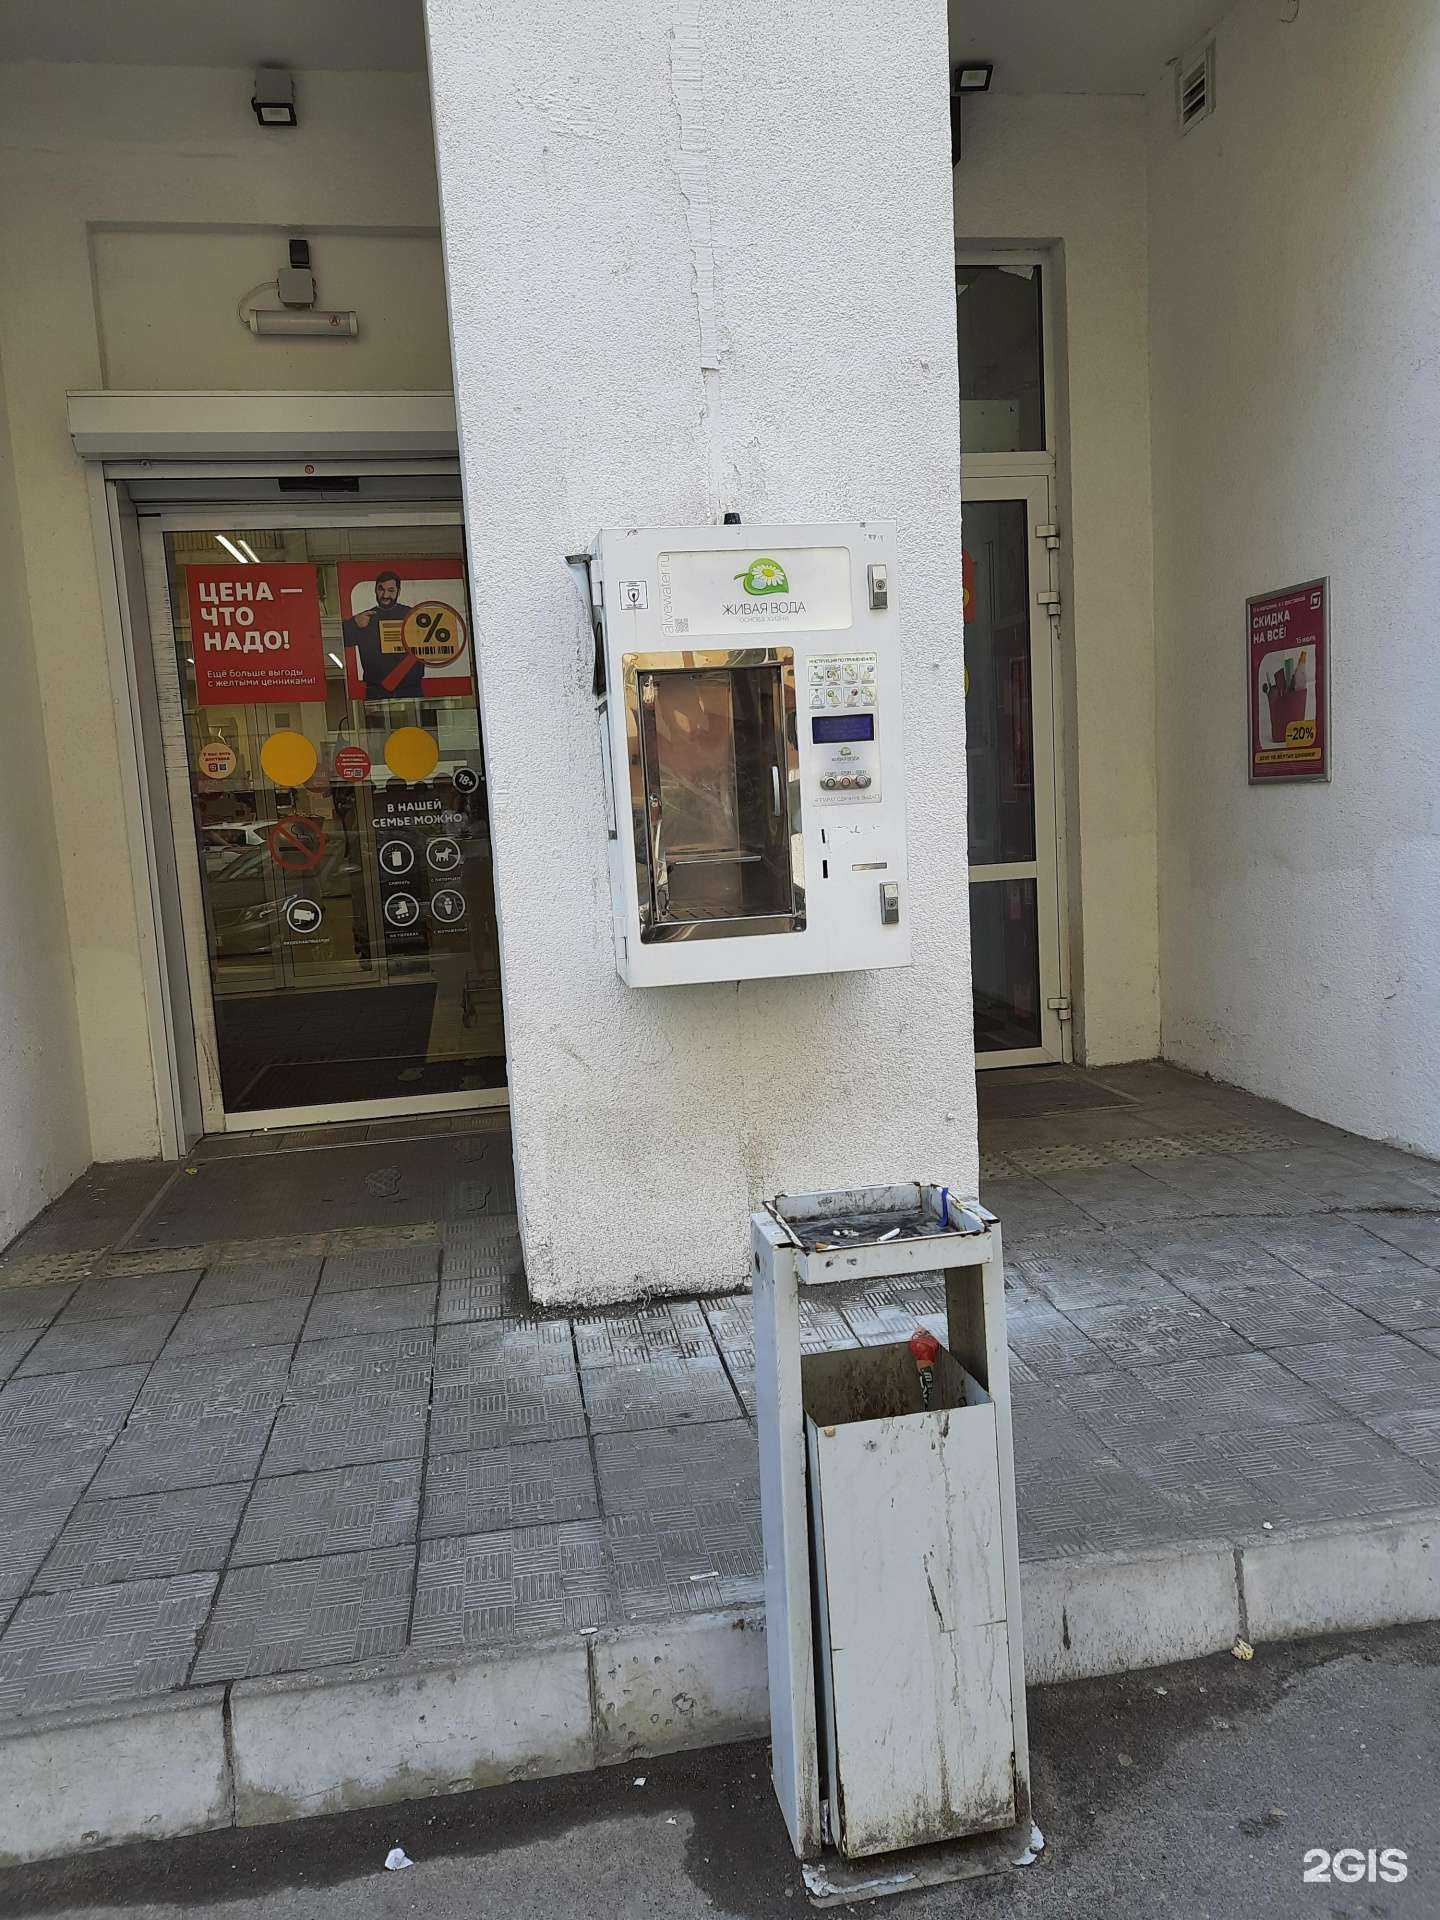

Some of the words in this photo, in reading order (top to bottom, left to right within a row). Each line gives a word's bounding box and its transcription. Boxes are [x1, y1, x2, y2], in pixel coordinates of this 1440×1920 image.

[199, 582, 274, 605] ЦЕНА
[201, 606, 254, 626] ЧТО
[722, 602, 768, 616] ЖИВАЯ
[771, 601, 807, 615] ВОДА
[415, 612, 450, 643] %
[1252, 610, 1291, 629] СКИДКА
[203, 630, 291, 653] НАДО!
[1253, 632, 1266, 644] НА
[1267, 625, 1287, 642] ВСЁ!
[228, 668, 265, 677] больше
[266, 668, 304, 678] выгоды
[260, 677, 316, 688] ценниками!
[459, 773, 474, 787] 18+
[387, 803, 395, 812] В
[397, 799, 442, 812] НАШЕЙ
[372, 816, 411, 828] СЕМЬЕ
[413, 813, 463, 826] МОЖНО
